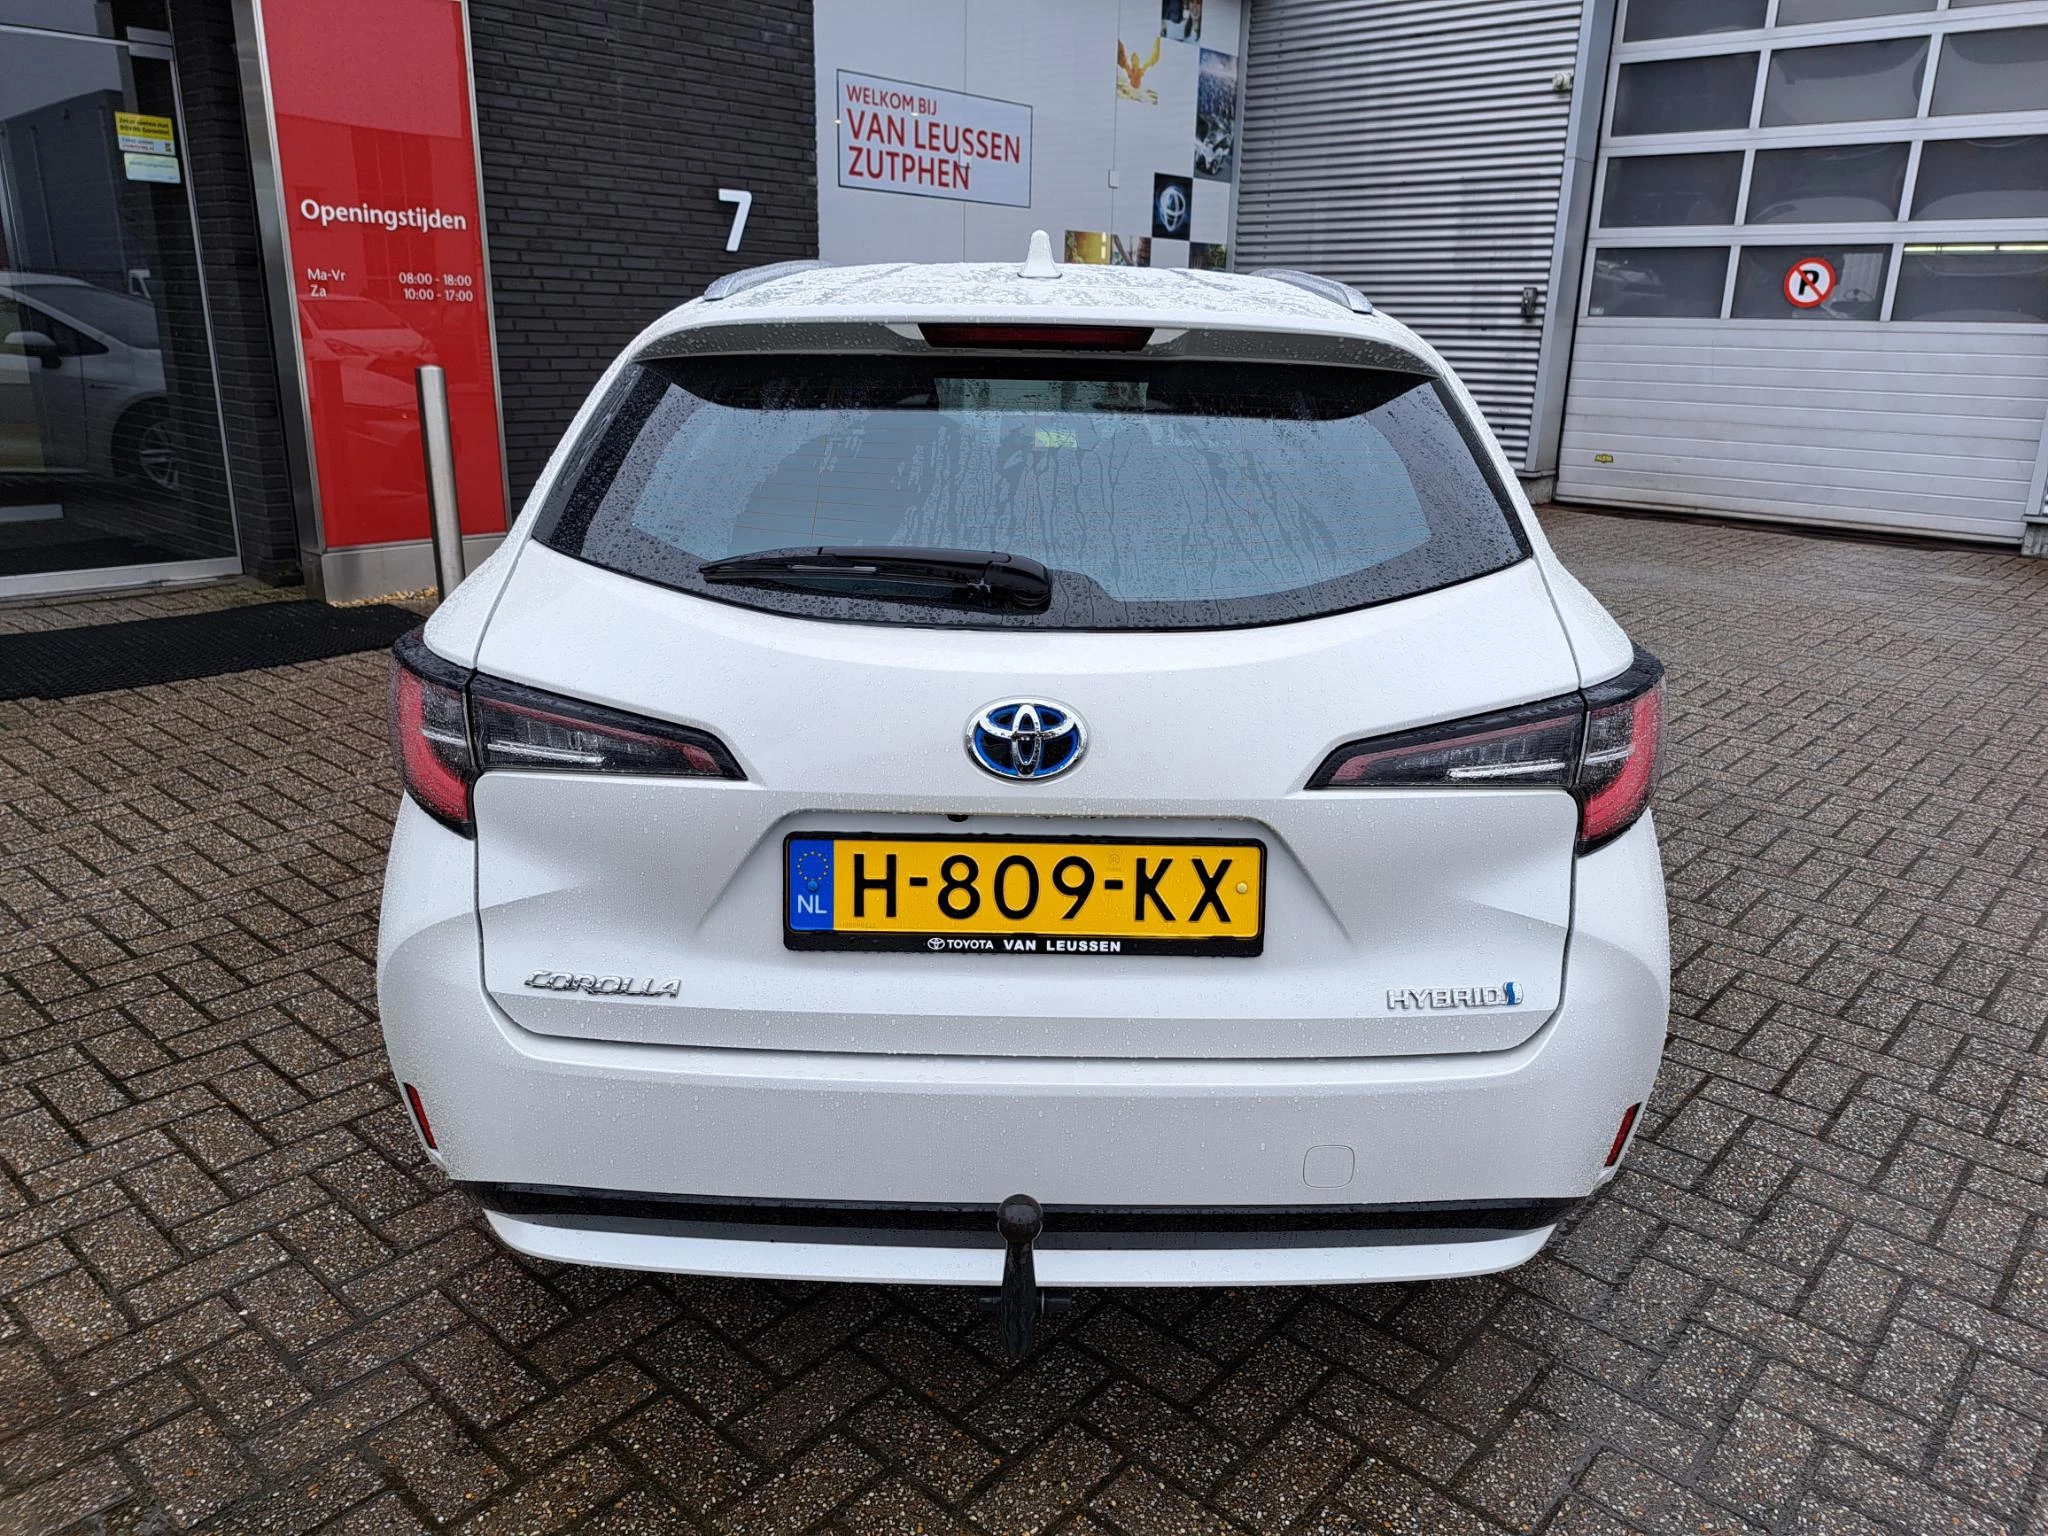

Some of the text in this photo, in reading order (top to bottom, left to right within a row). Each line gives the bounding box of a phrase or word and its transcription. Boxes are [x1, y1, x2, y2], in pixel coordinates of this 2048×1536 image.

[846, 84, 938, 116] WELKOM BIJ
[847, 108, 1021, 164] VAN LEUSSEN
[848, 145, 971, 190] ZUTPHEN
[300, 199, 467, 233] Openingstijden
[718, 188, 753, 252] 7
[307, 268, 346, 281] Ma-Vr
[398, 272, 433, 285] 08:00
[443, 274, 472, 286] 18:00
[310, 284, 327, 297] Za
[403, 288, 434, 300] 10:00
[444, 290, 473, 302] 17:00
[853, 853, 1233, 923] H-809-KX
[797, 894, 828, 914] NL
[946, 939, 1121, 952] TOYOTA VAN LEUSSEN
[524, 970, 682, 998] COROLLA
[1387, 987, 1504, 1009] HYBRID
